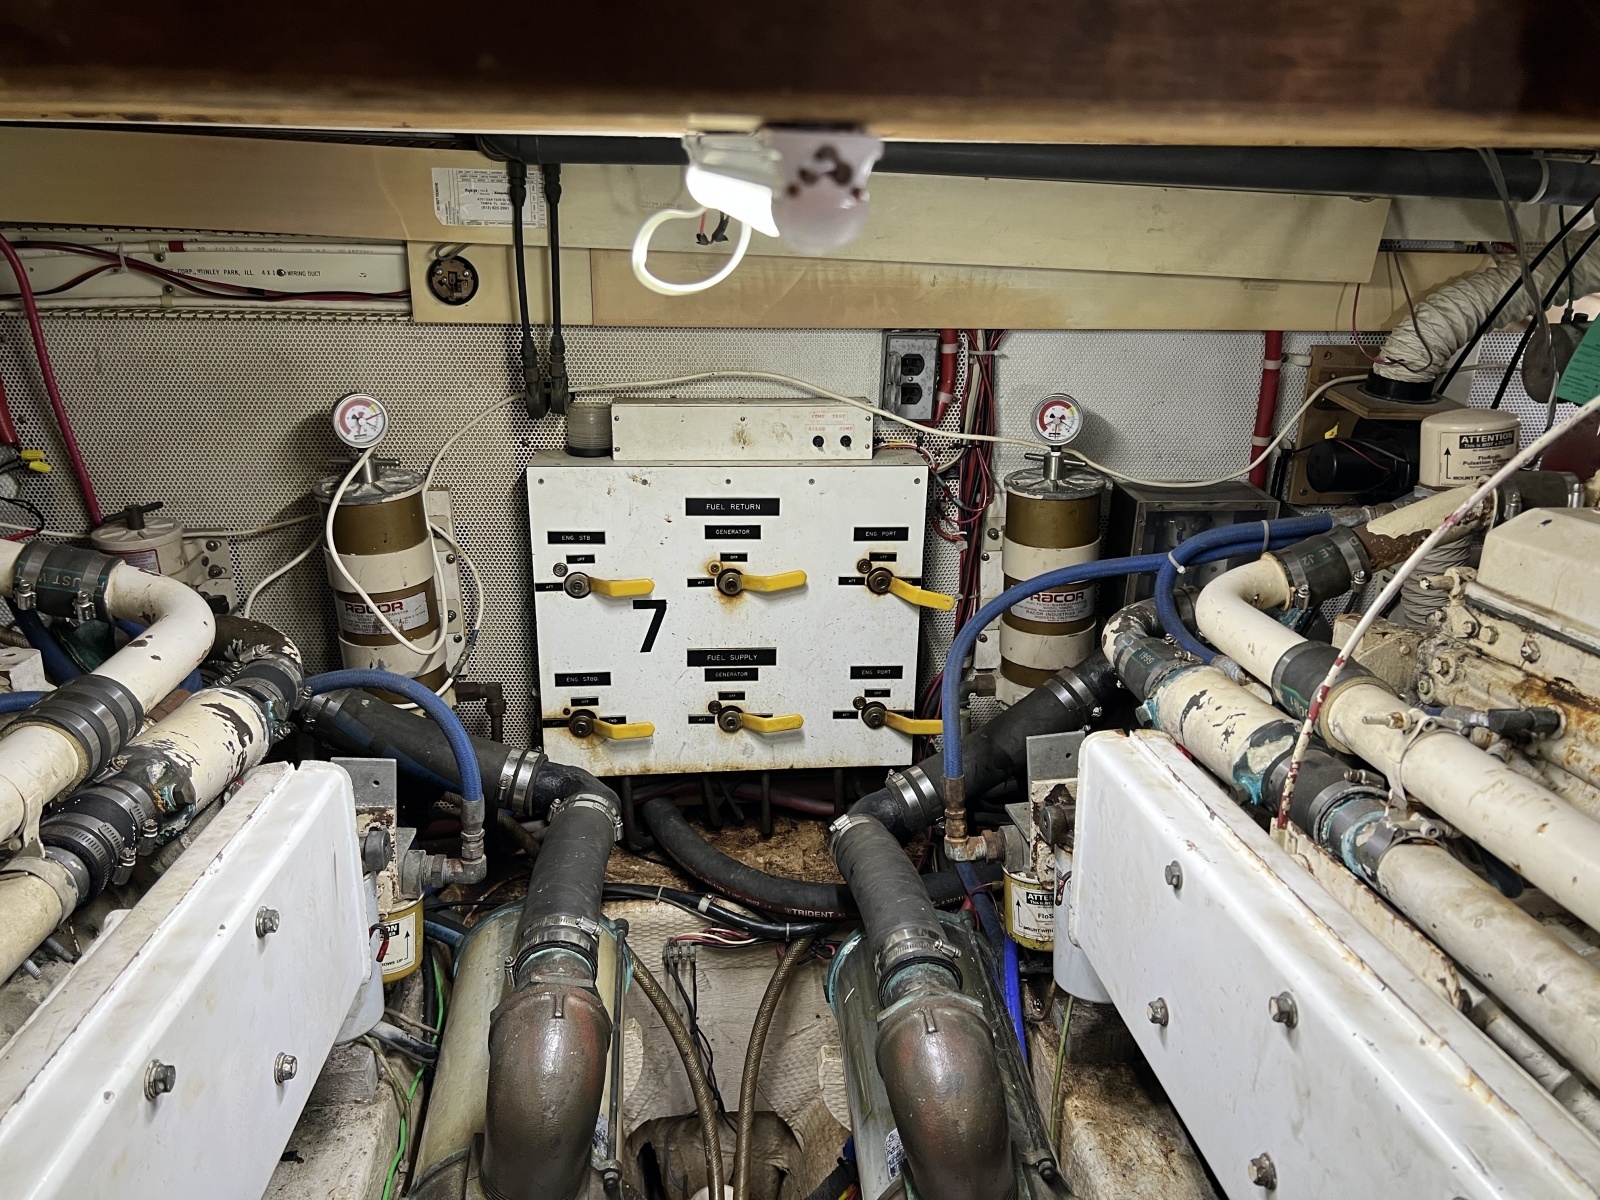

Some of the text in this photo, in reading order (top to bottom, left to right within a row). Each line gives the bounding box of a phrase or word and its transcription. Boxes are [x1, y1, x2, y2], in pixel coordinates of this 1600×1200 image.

[1461, 431, 1514, 444] ATTENTION
[705, 503, 761, 511] FUEL RETURN
[631, 598, 668, 654] 7
[1027, 893, 1055, 901] ATTEN
[792, 908, 835, 918] TRIDENT
